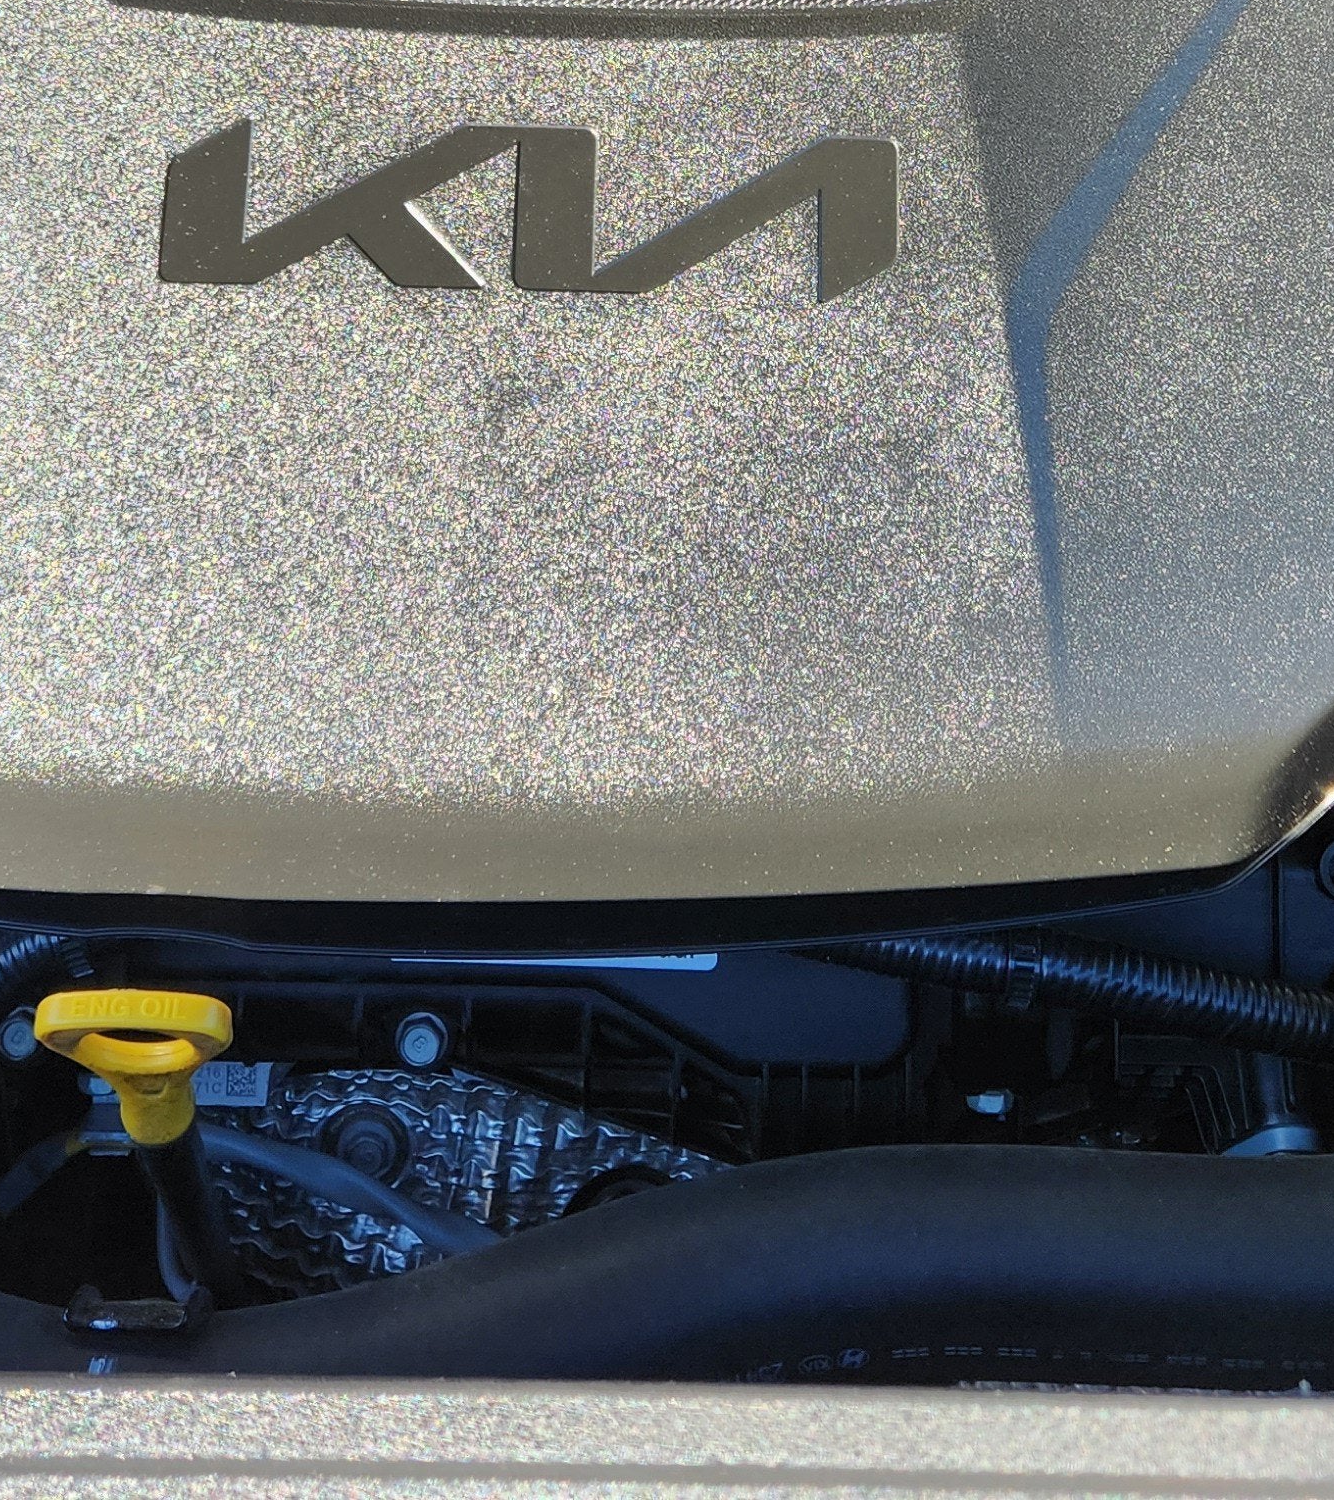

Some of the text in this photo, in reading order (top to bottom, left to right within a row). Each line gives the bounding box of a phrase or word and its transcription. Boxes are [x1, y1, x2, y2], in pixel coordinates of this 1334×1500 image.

[157, 117, 901, 304] KIA
[71, 996, 186, 1020] ENG OIL
